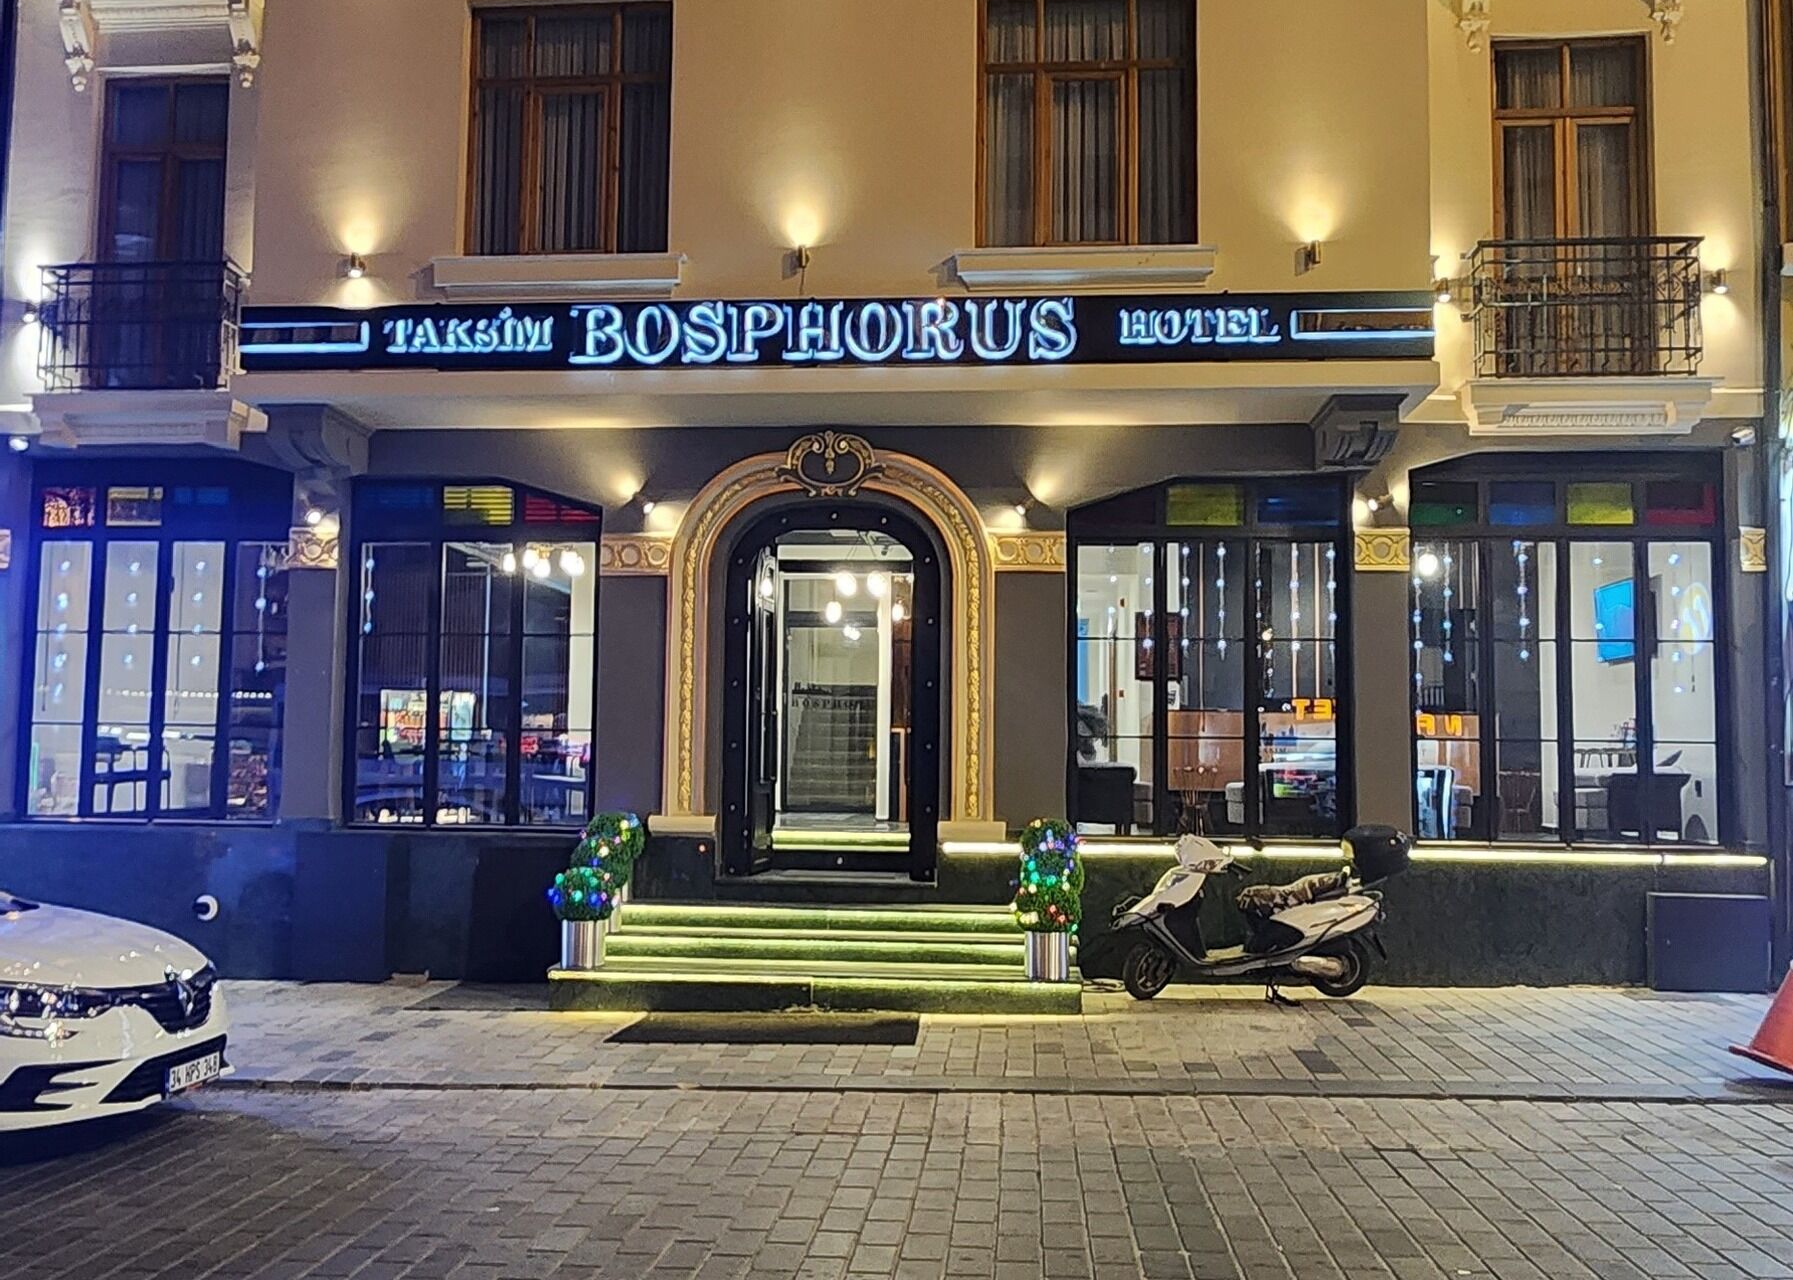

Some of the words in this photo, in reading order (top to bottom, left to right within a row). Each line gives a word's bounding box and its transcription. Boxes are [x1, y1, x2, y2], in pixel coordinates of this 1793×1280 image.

[384, 306, 554, 354] TAKSİM
[568, 298, 1078, 365] BOSPHORUS
[1119, 307, 1282, 345] HOTEL
[171, 1069, 181, 1088] 34
